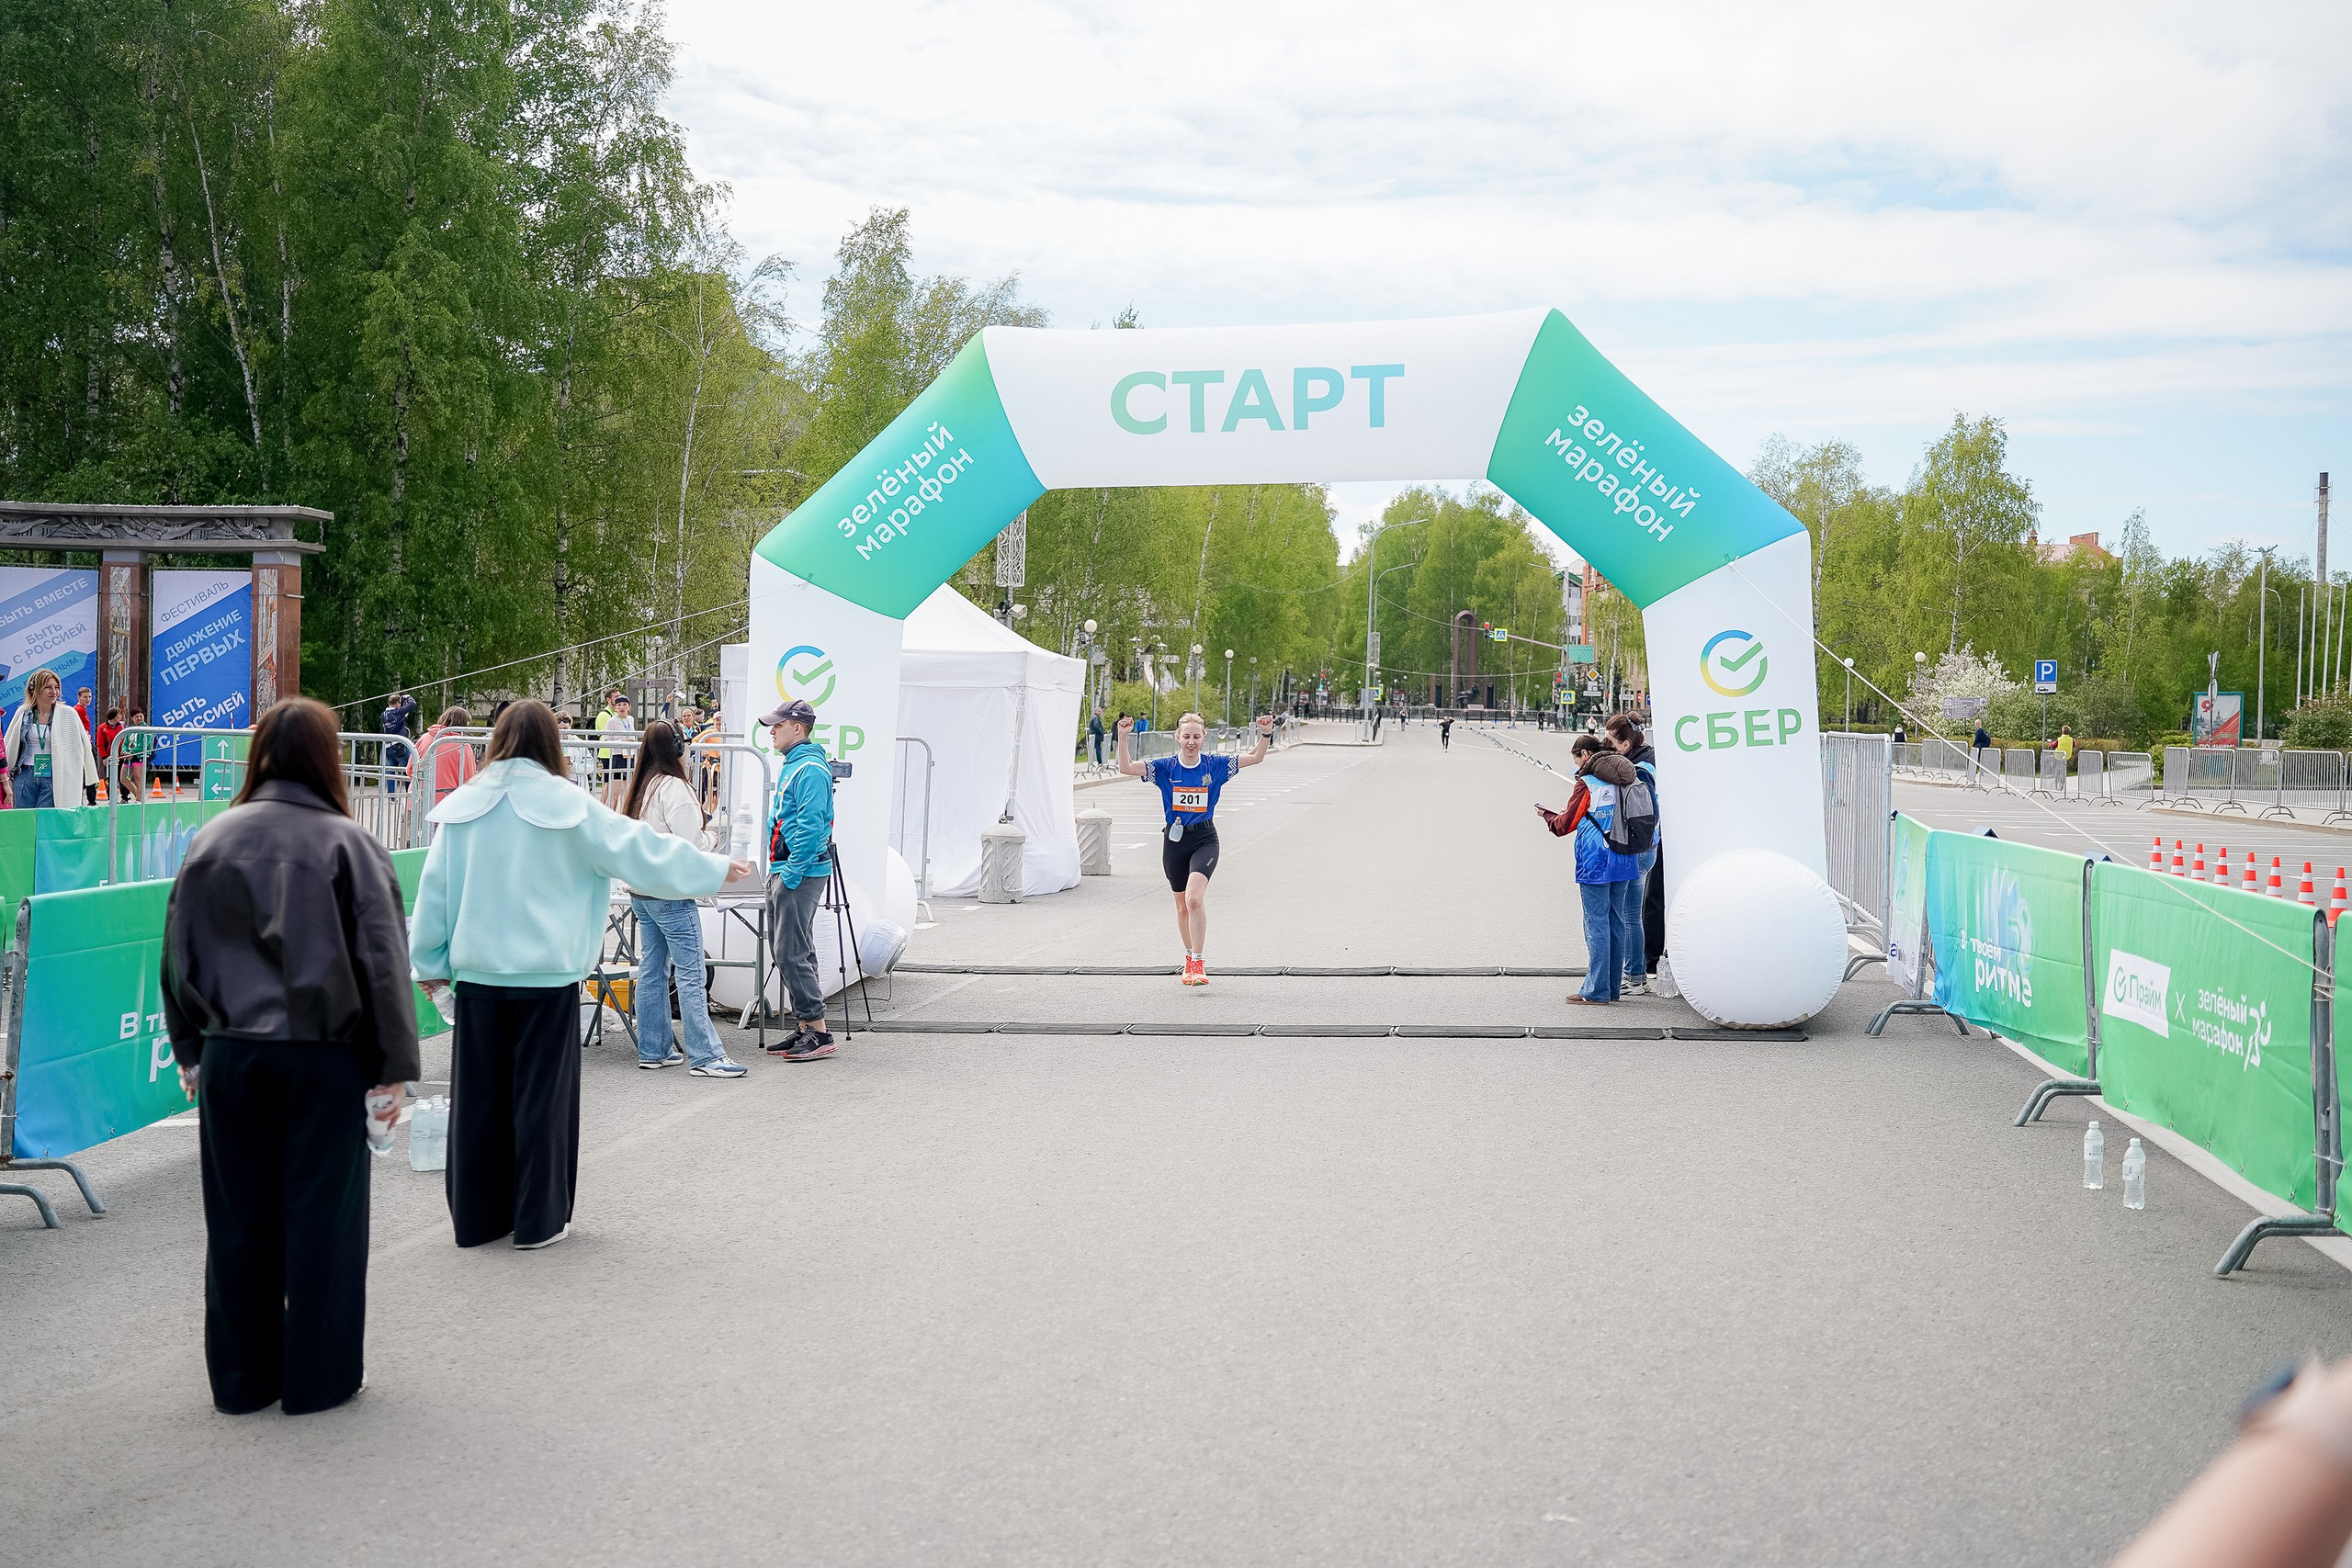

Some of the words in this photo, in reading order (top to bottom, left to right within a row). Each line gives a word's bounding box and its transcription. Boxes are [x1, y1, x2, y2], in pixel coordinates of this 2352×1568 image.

[1110, 364, 1405, 435] СТАРТ
[836, 420, 955, 539] зелёный
[1566, 404, 1702, 519] зелёный
[854, 447, 975, 561] марафон
[1544, 427, 1675, 543] марафон
[34, 577, 88, 610] ВМЕСТЕ
[160, 581, 229, 623] ФЕСТИВАЛЬ
[12, 654, 23, 664] С
[25, 621, 86, 659] РОССИЕЙ
[25, 623, 63, 645] БЫТЬ
[164, 608, 243, 661] ДВИЖЕНИЕ
[160, 628, 246, 686] ПЕРВЫХ
[2041, 662, 2053, 681] P
[0, 685, 22, 701] ЫТЬ
[162, 696, 207, 727] БЫТЬ
[752, 721, 865, 761] СЕР
[1674, 708, 1803, 752] СБЕР
[1180, 794, 1200, 805] 201
[1974, 957, 2032, 1008] ритме
[2130, 974, 2162, 1011] Прайм
[2198, 987, 2247, 1026] зелёный
[2192, 1017, 2244, 1056] марафон
